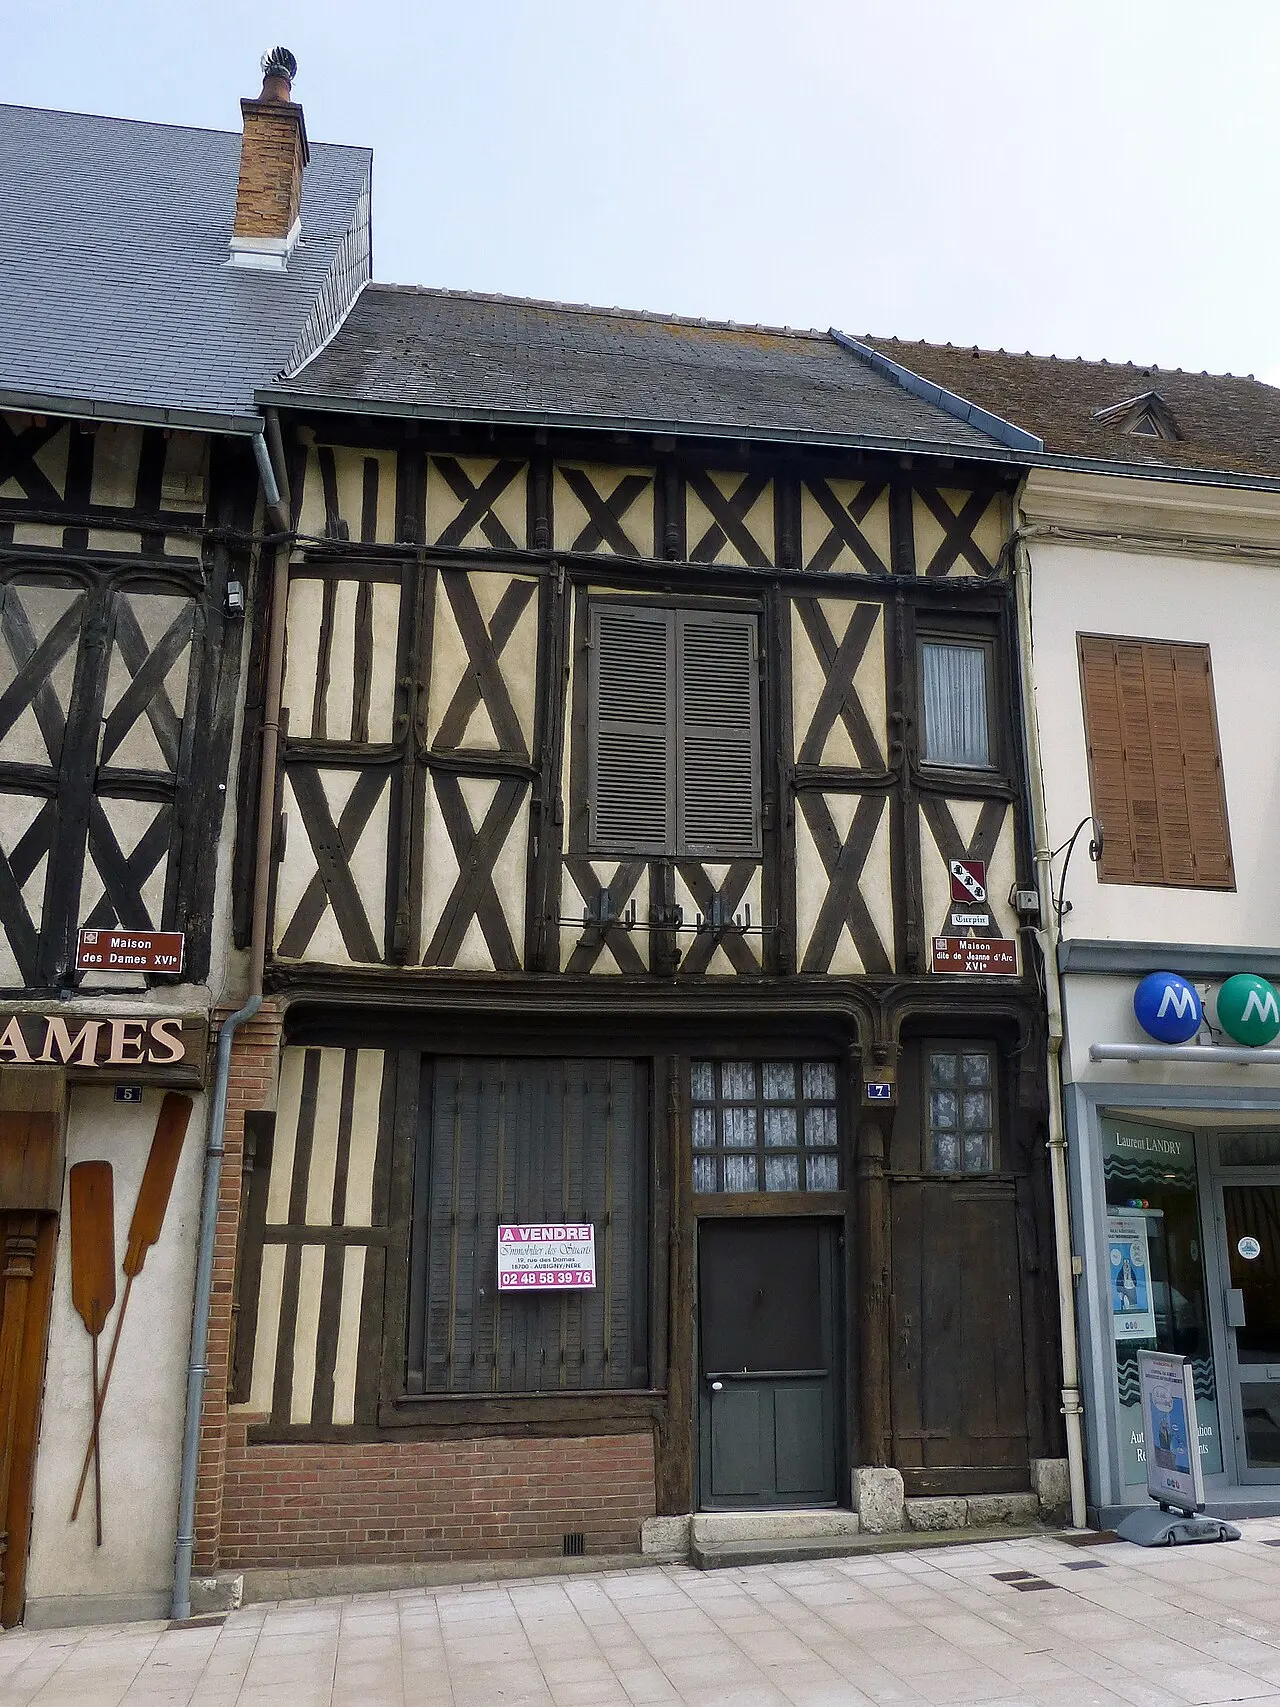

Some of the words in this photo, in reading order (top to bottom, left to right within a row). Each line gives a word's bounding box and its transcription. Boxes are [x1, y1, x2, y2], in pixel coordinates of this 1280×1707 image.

[111, 938, 151, 948] Maison
[960, 941, 990, 950] Maison
[83, 953, 102, 962] des
[110, 954, 146, 964] Dames
[967, 952, 990, 960] Jeanne
[124, 1089, 132, 1099] 5
[876, 1086, 883, 1096] 7
[1116, 1133, 1144, 1151] Laurent
[1146, 1139, 1181, 1155] LANDRY
[502, 1229, 514, 1240] A
[519, 1228, 590, 1240] VENDRE
[503, 1274, 517, 1284] 02
[521, 1274, 536, 1284] 48
[540, 1273, 554, 1284] 58
[558, 1273, 572, 1283] 39
[576, 1272, 591, 1282] 76
